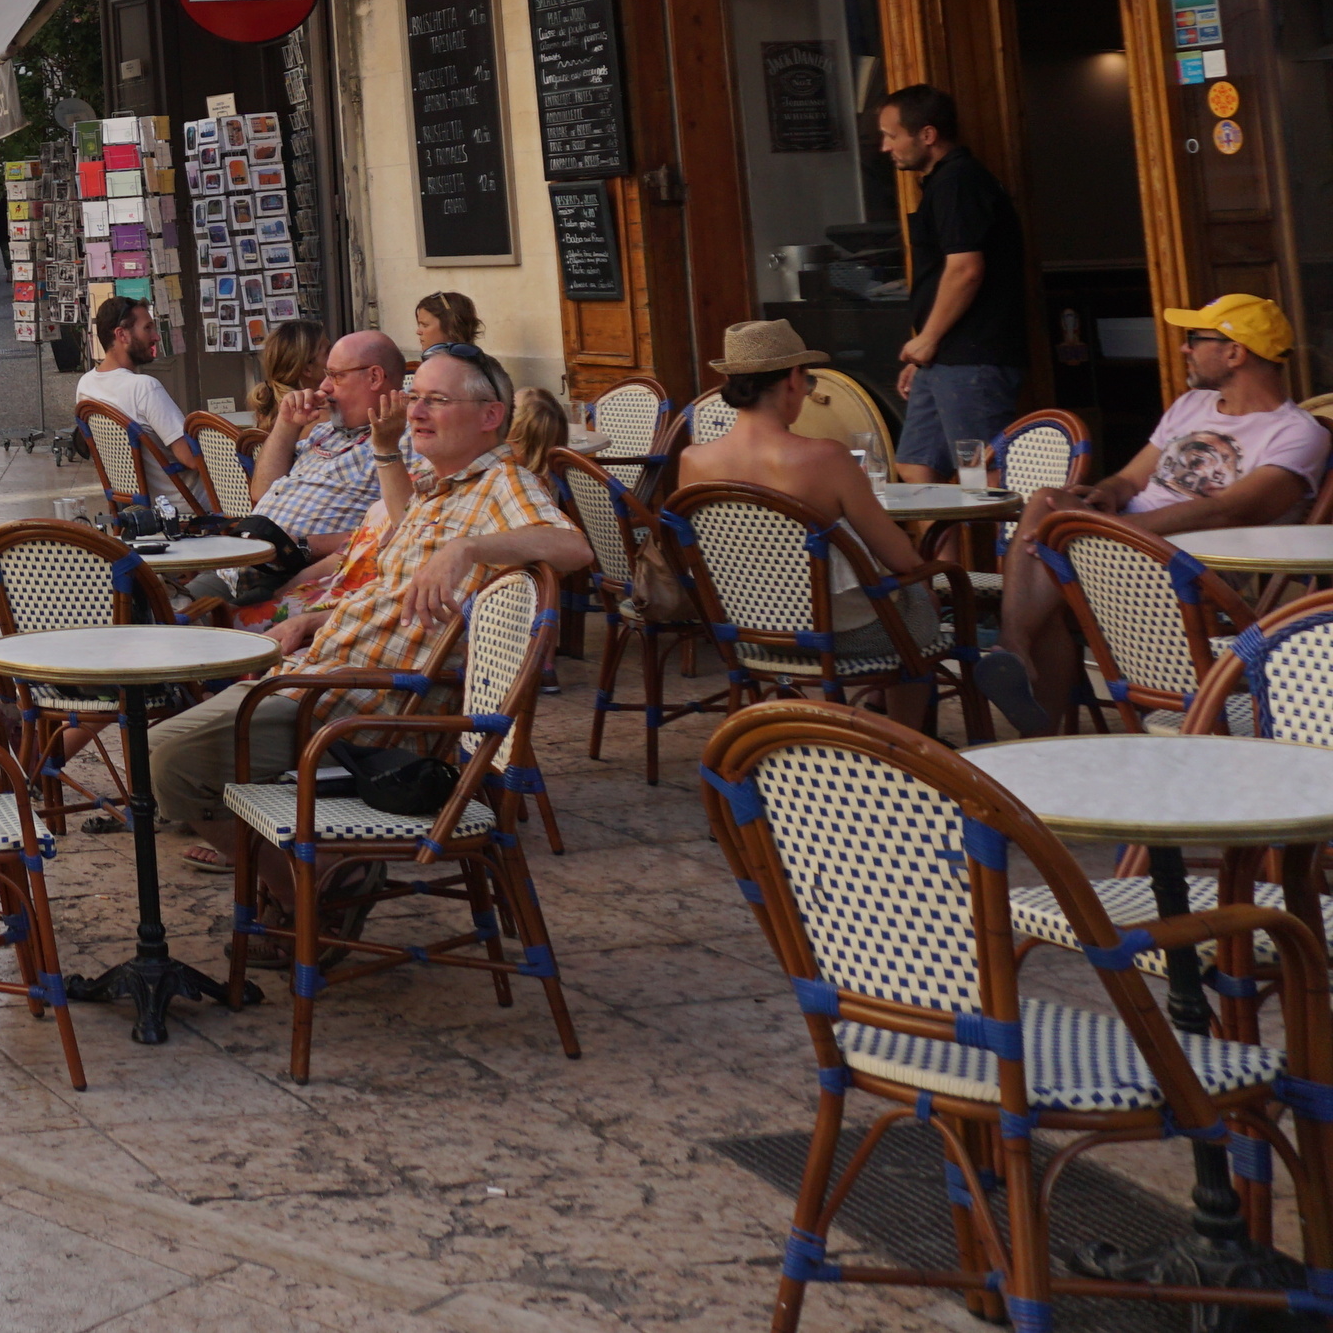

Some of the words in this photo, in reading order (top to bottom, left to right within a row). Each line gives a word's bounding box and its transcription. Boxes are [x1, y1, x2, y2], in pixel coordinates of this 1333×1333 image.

[412, 7, 459, 36] BRUSCHETTA
[430, 29, 467, 54] TAPENADE
[426, 149, 433, 167] 3
[565, 233, 583, 244] Baba
